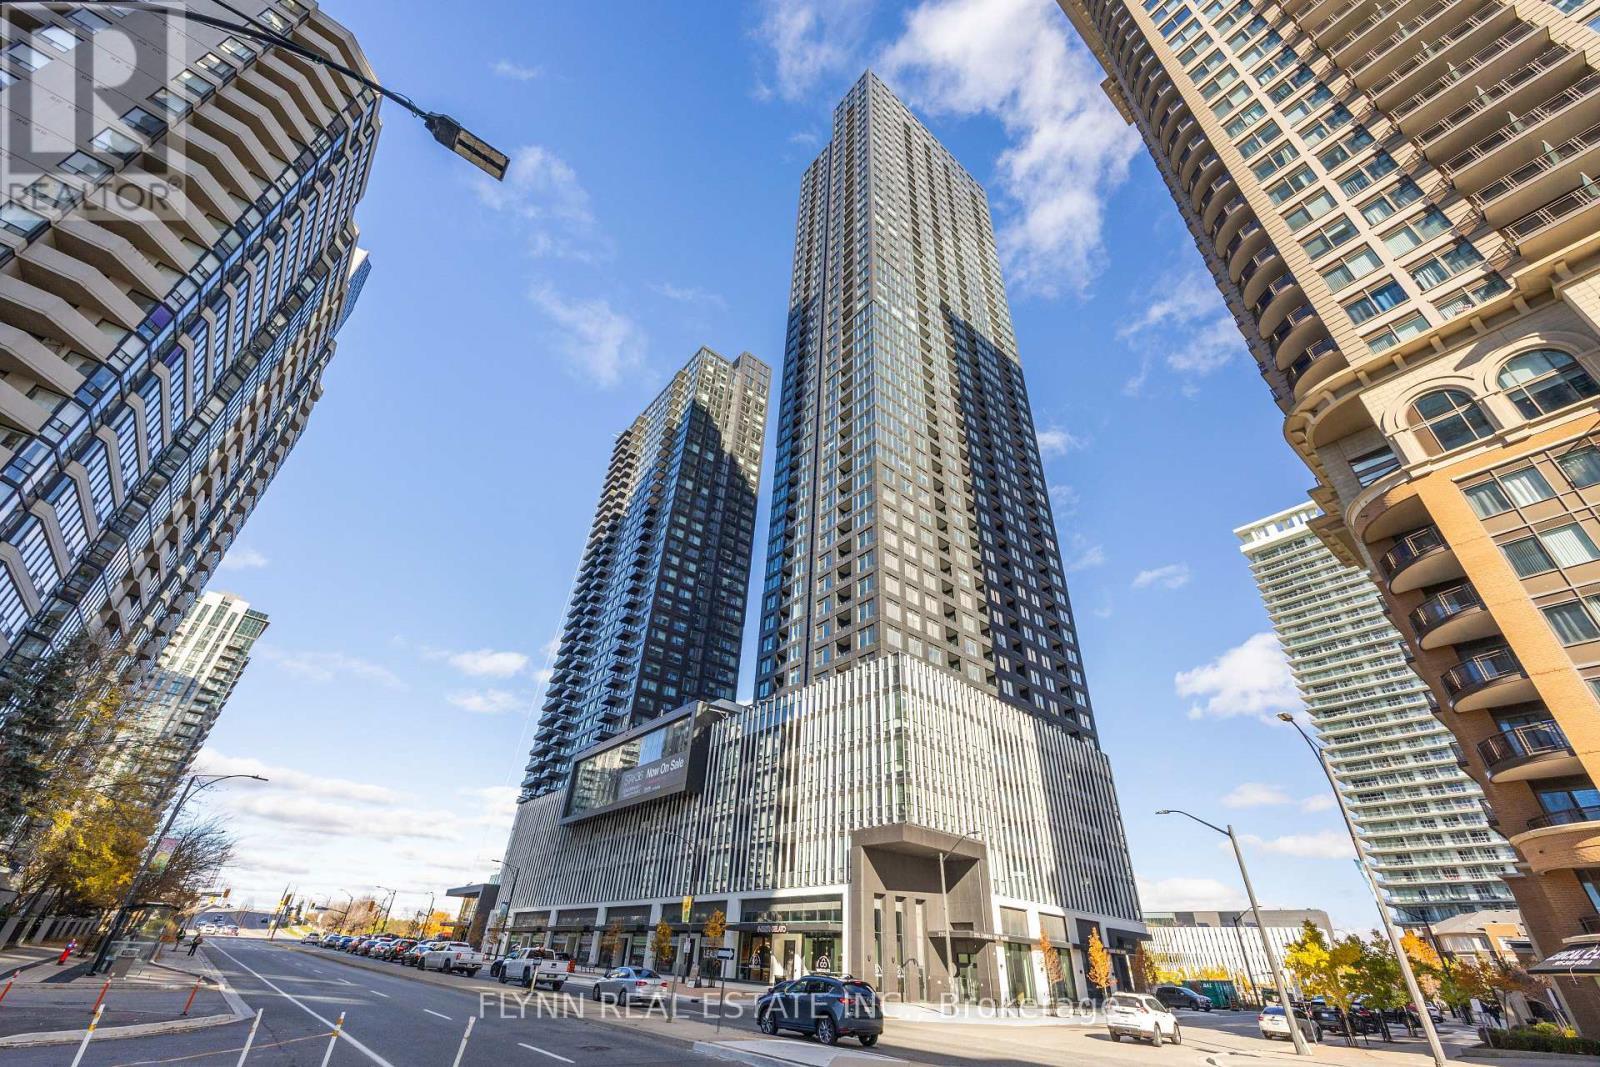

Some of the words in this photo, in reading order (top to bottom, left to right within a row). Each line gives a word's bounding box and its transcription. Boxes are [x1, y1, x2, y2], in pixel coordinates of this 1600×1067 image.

[645, 767, 660, 778] Now
[660, 762, 670, 775] On
[670, 757, 684, 771] Sale
